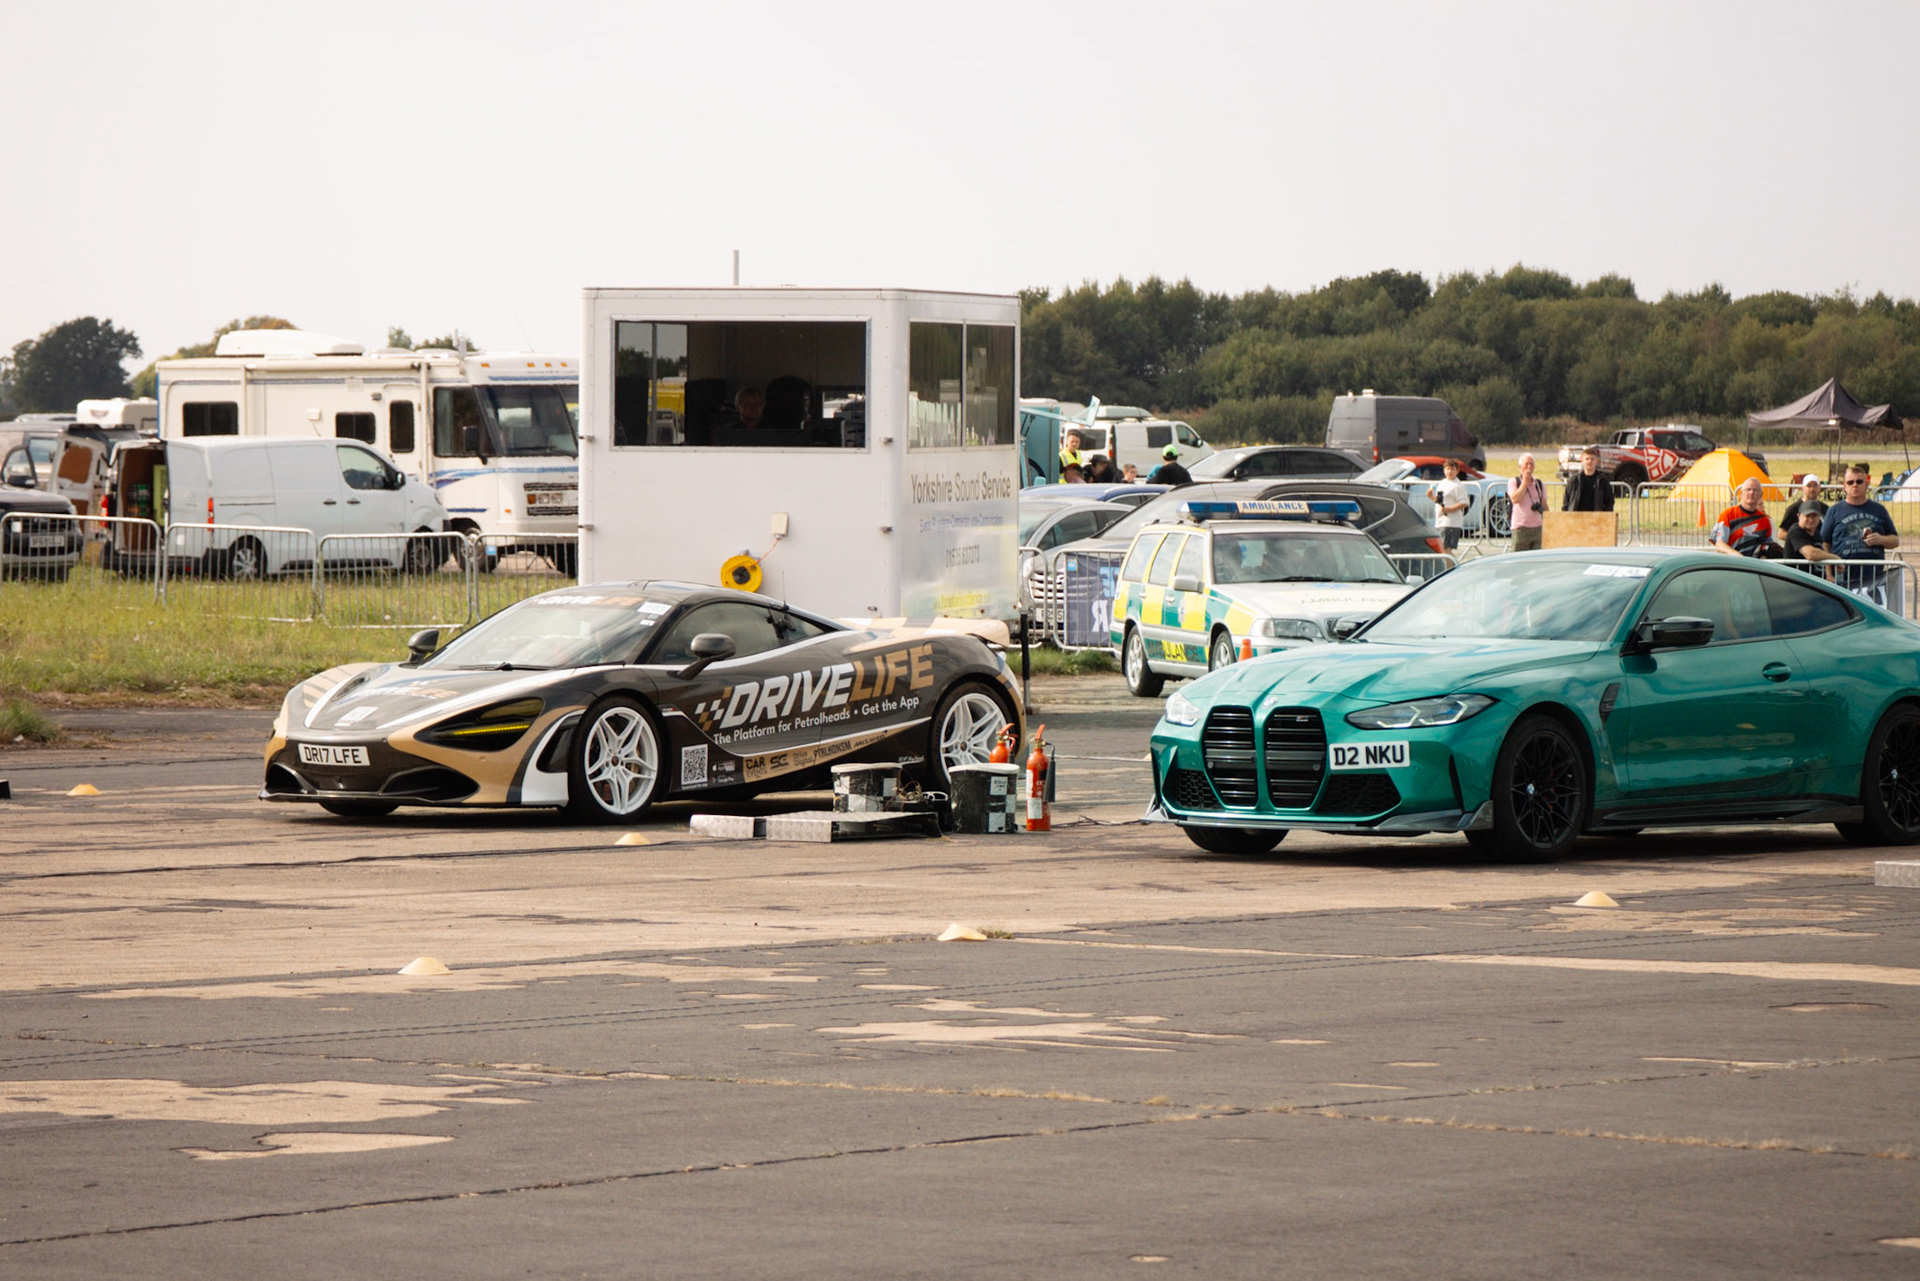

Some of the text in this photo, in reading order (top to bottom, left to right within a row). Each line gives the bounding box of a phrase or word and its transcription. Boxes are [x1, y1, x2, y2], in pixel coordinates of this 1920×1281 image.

[911, 470, 1011, 504] Yorkshire Sound Service
[1242, 502, 1305, 510] AMBULANCE
[719, 644, 934, 729] DRIVELIFE
[713, 694, 920, 745] The Platform for Petrolheads Get the App
[304, 746, 362, 764] DR17 LFE
[745, 756, 765, 770] CAR
[1333, 744, 1404, 766] D2 NKU
[747, 767, 768, 778] EVENTS
